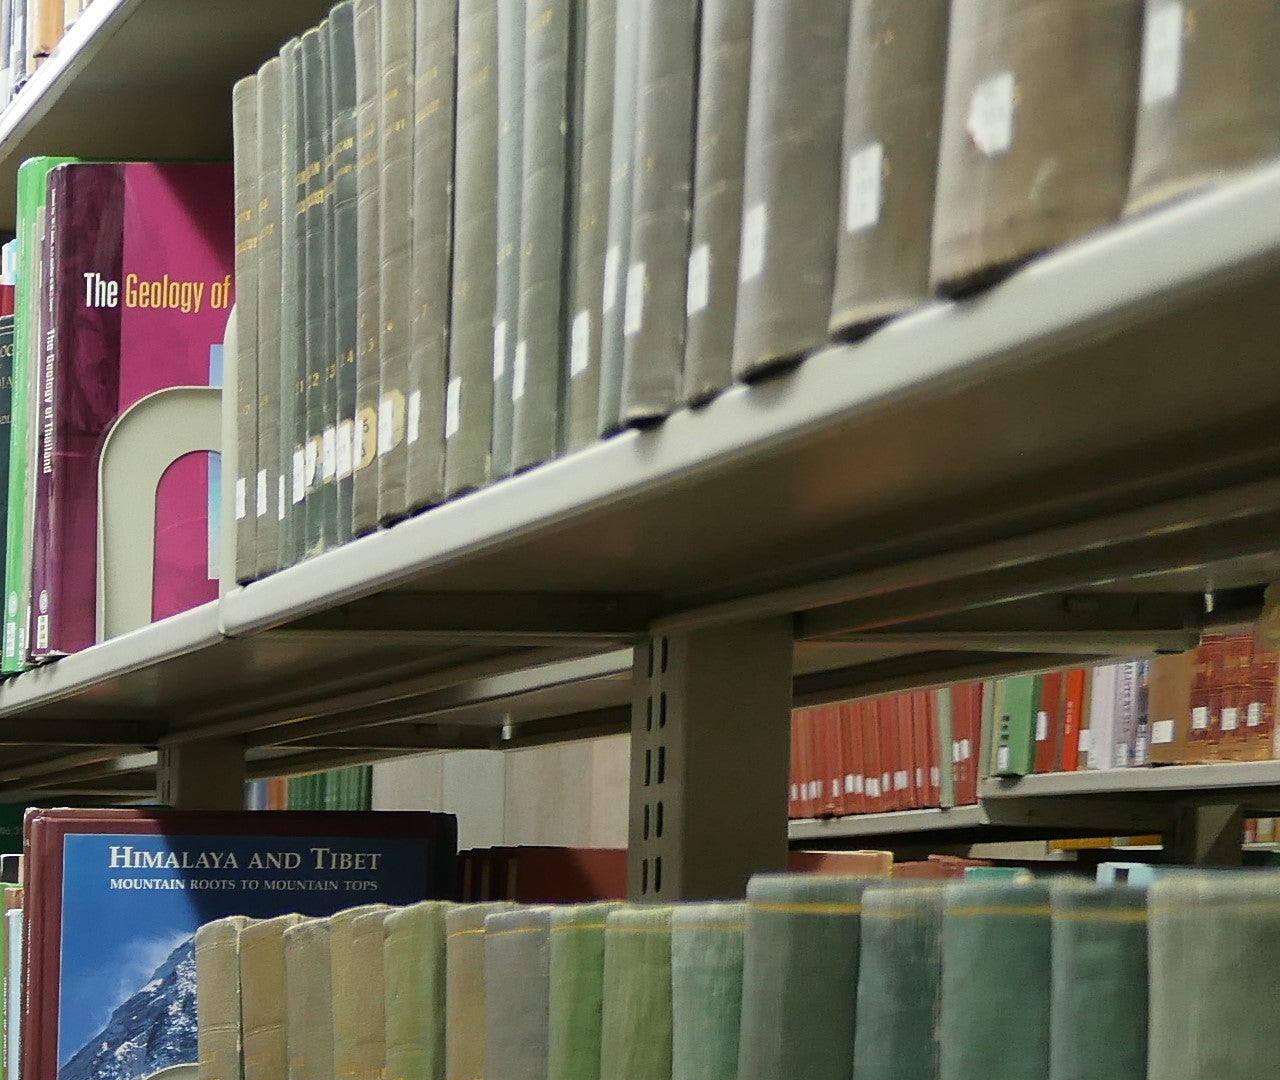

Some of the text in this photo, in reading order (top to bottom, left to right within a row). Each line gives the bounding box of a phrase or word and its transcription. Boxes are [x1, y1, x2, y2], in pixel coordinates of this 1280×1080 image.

[83, 272, 231, 313] The Geology of
[42, 328, 56, 473] The Geology of Thailand
[109, 878, 378, 892] MOUNTAIN ROOTS TO MOUNTAIN TOPS
